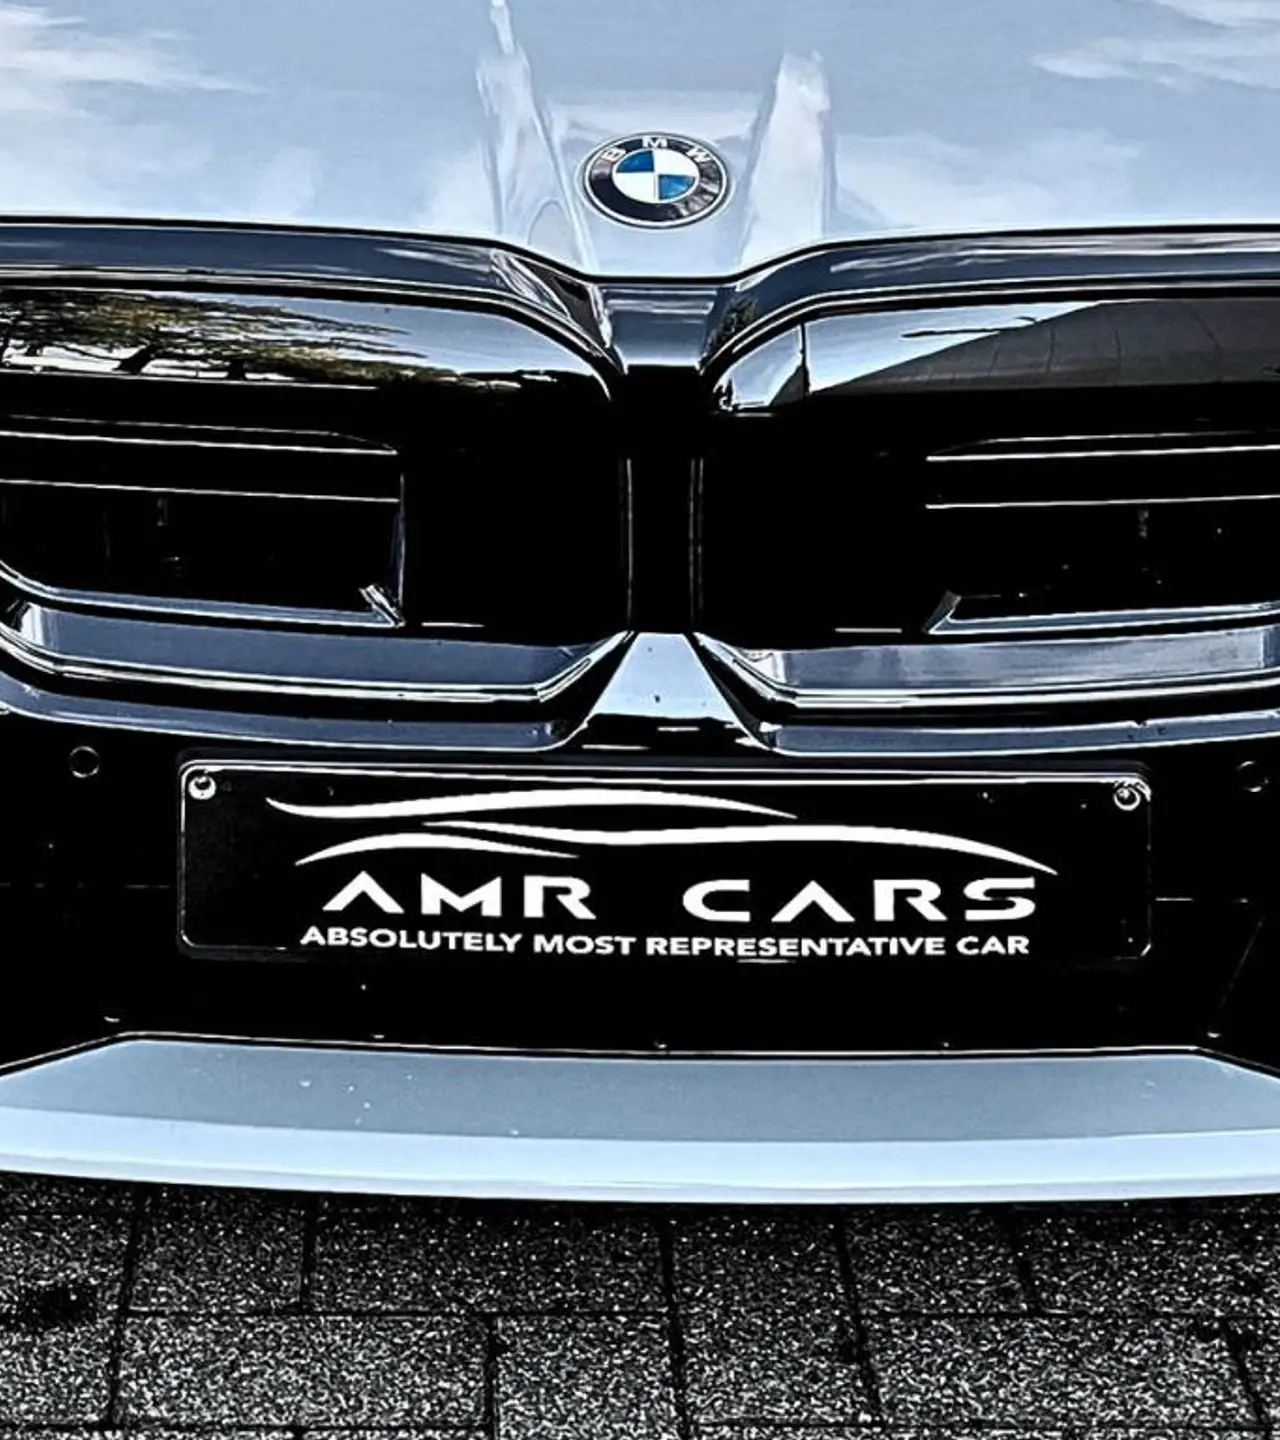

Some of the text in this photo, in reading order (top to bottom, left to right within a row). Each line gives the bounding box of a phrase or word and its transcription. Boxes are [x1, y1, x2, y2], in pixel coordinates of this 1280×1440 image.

[322, 871, 1036, 923] AMR CARS
[300, 924, 1030, 957] ABSOLUTELY MOST REPRESENTATIVE CAR
